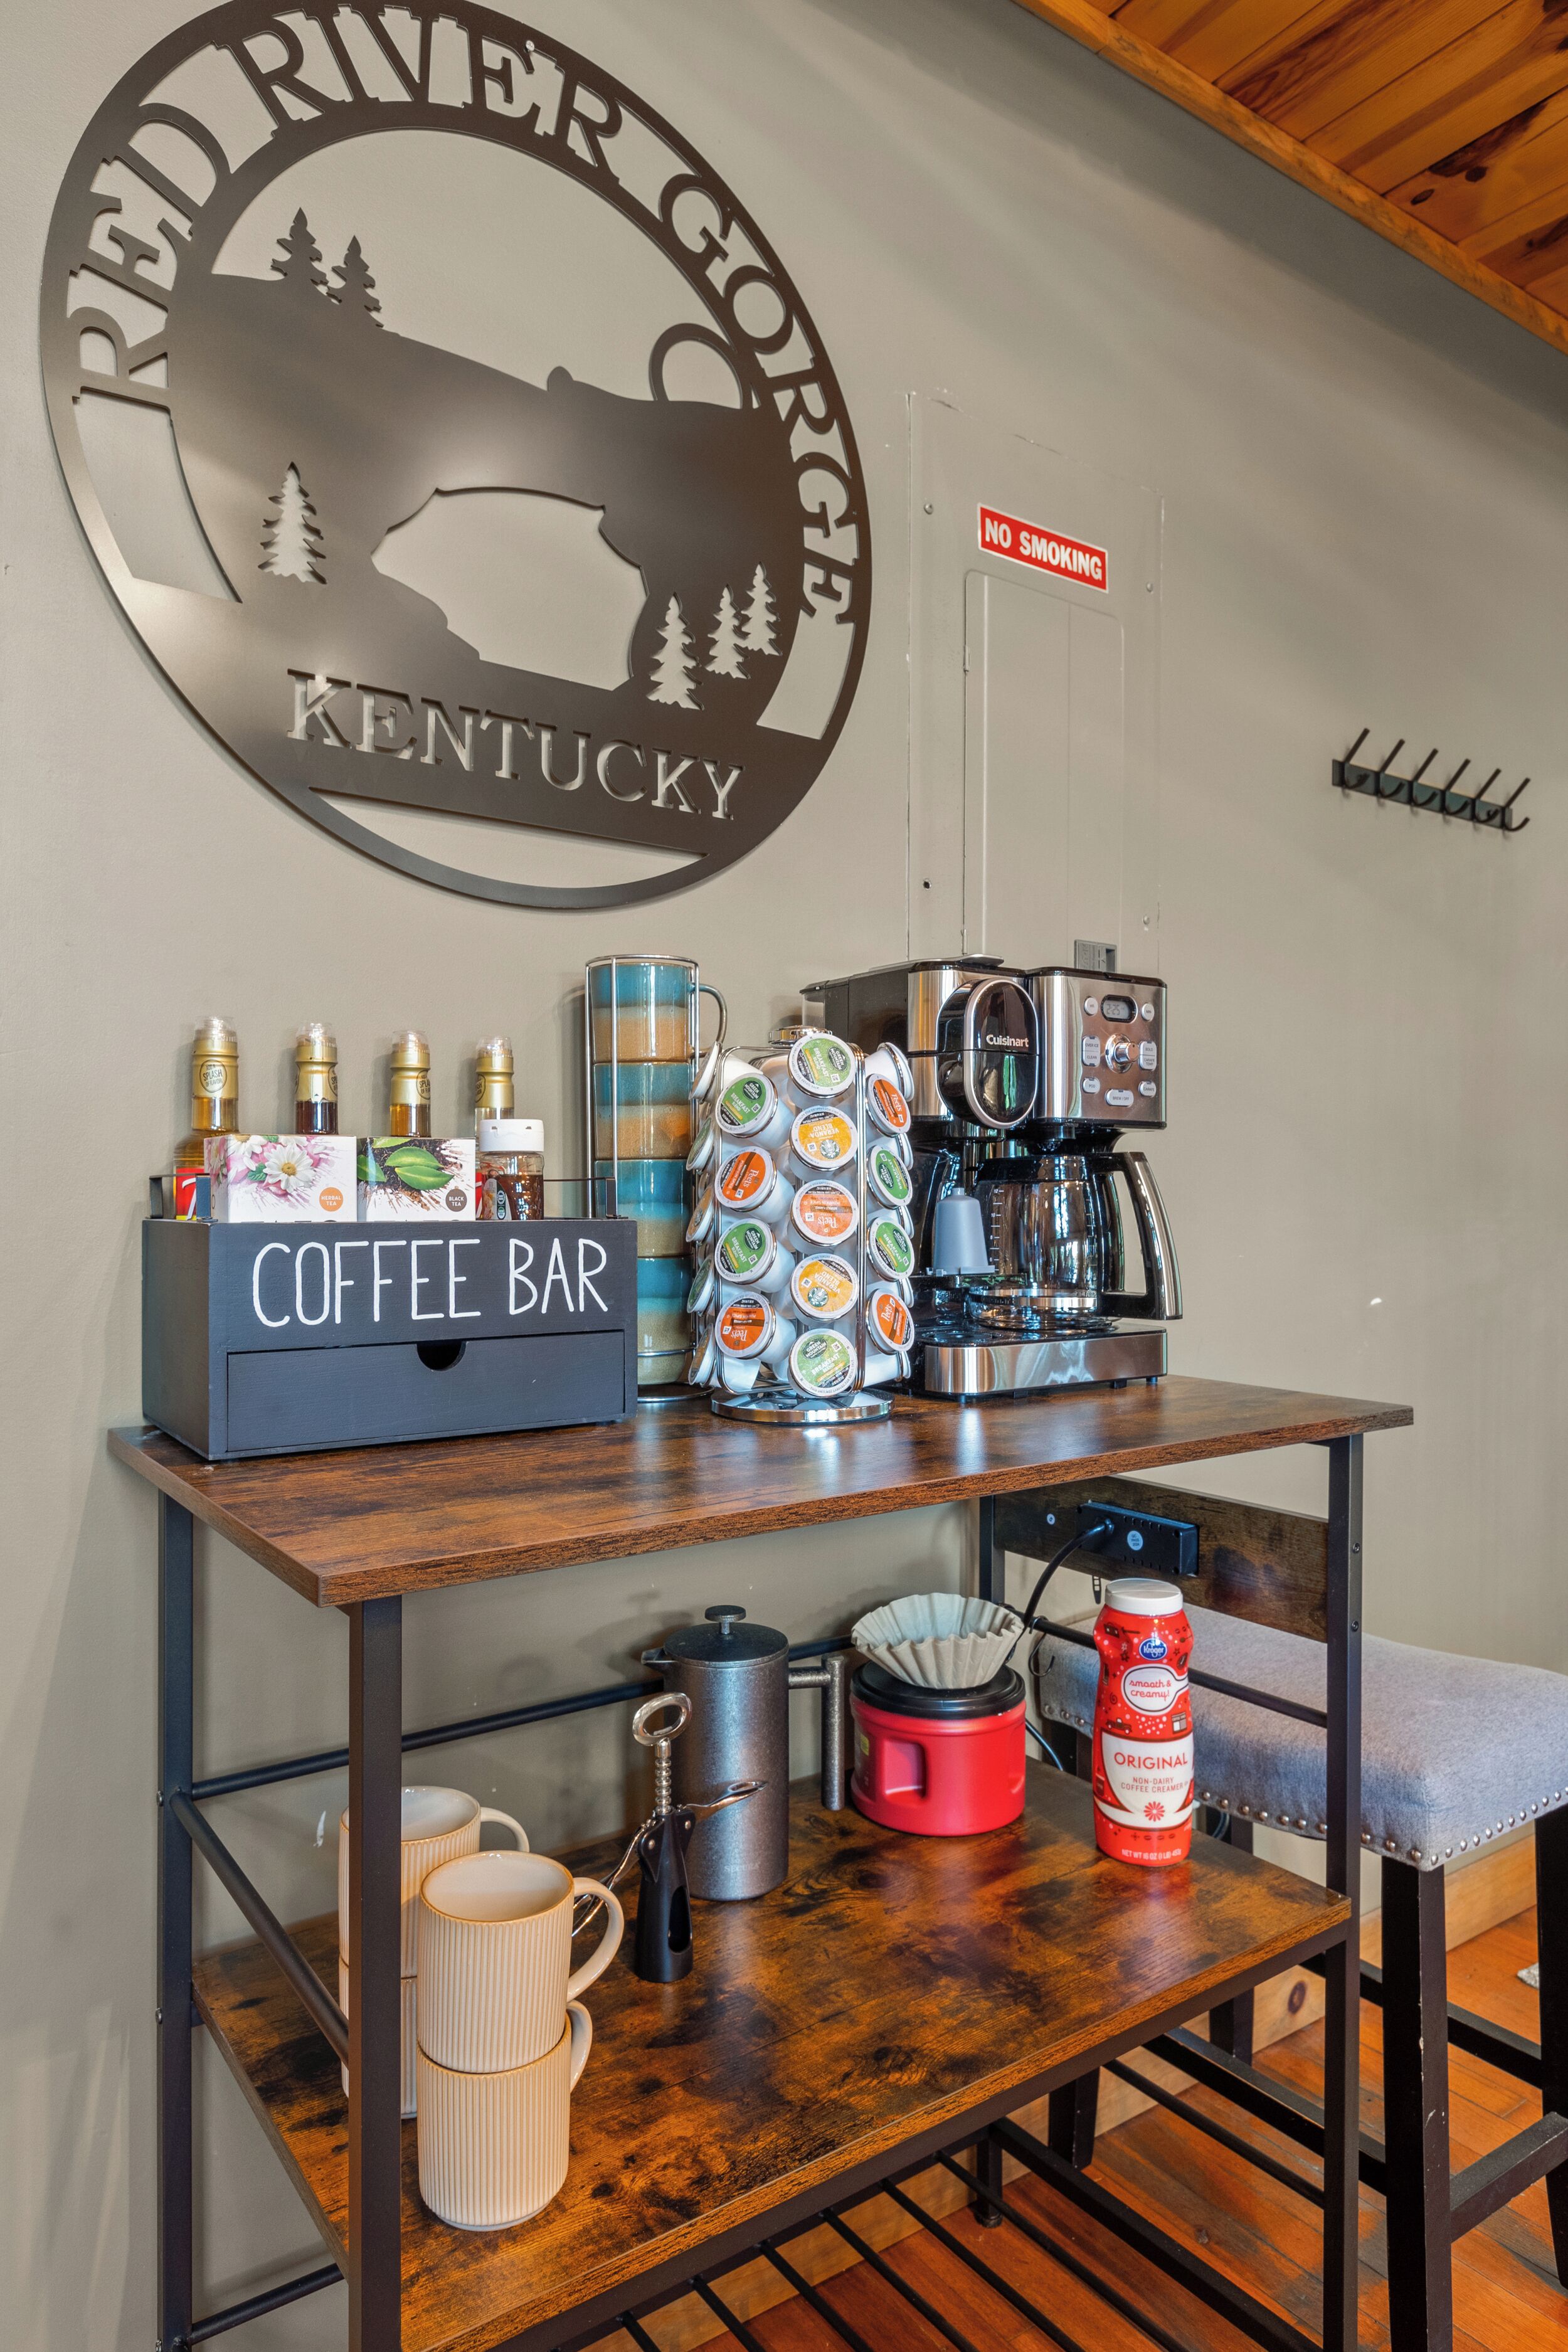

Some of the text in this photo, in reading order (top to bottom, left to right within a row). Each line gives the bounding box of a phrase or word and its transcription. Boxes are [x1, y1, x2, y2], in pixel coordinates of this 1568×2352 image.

[65, 3, 861, 625] RED RIVER GORGE
[985, 517, 1102, 580] NO SMOKING
[286, 668, 746, 821] KENTUCKY
[986, 1034, 1029, 1047] Cuisinart
[813, 1047, 829, 1076] BREAKFAST
[830, 1049, 842, 1070] MOUNTAIN
[836, 1051, 844, 1065] GREEN
[203, 1069, 222, 1081] SPLASH
[744, 1084, 759, 1099] MOUNTAIN
[749, 1083, 760, 1093] GREEN
[731, 1093, 750, 1114] BREAKFAST
[810, 1128, 839, 1138] VERANDA
[813, 1123, 833, 1131] BLEND
[746, 1231, 758, 1249] MOUNTAIN
[751, 1231, 760, 1243] GREEN
[731, 1237, 747, 1263] BREAKFAST
[883, 1234, 902, 1263] BREAKFAST
[252, 1237, 608, 1327] COFFEE BAR
[814, 1273, 840, 1293] VERANDA
[822, 1271, 840, 1286] BLEND
[805, 1342, 827, 1359] MOUNTAIN
[807, 1341, 820, 1352] GREEN
[812, 1353, 840, 1375] BREAKFAST
[1144, 1642, 1164, 1657] Kroger
[1129, 1680, 1165, 1688] smooth
[1130, 1690, 1169, 1701] creamy!
[1114, 1752, 1188, 1769] ORIGINAL
[1121, 1783, 1183, 1793] COFFEE CREAMER
[1133, 1777, 1174, 1785] NON-DAIRY
